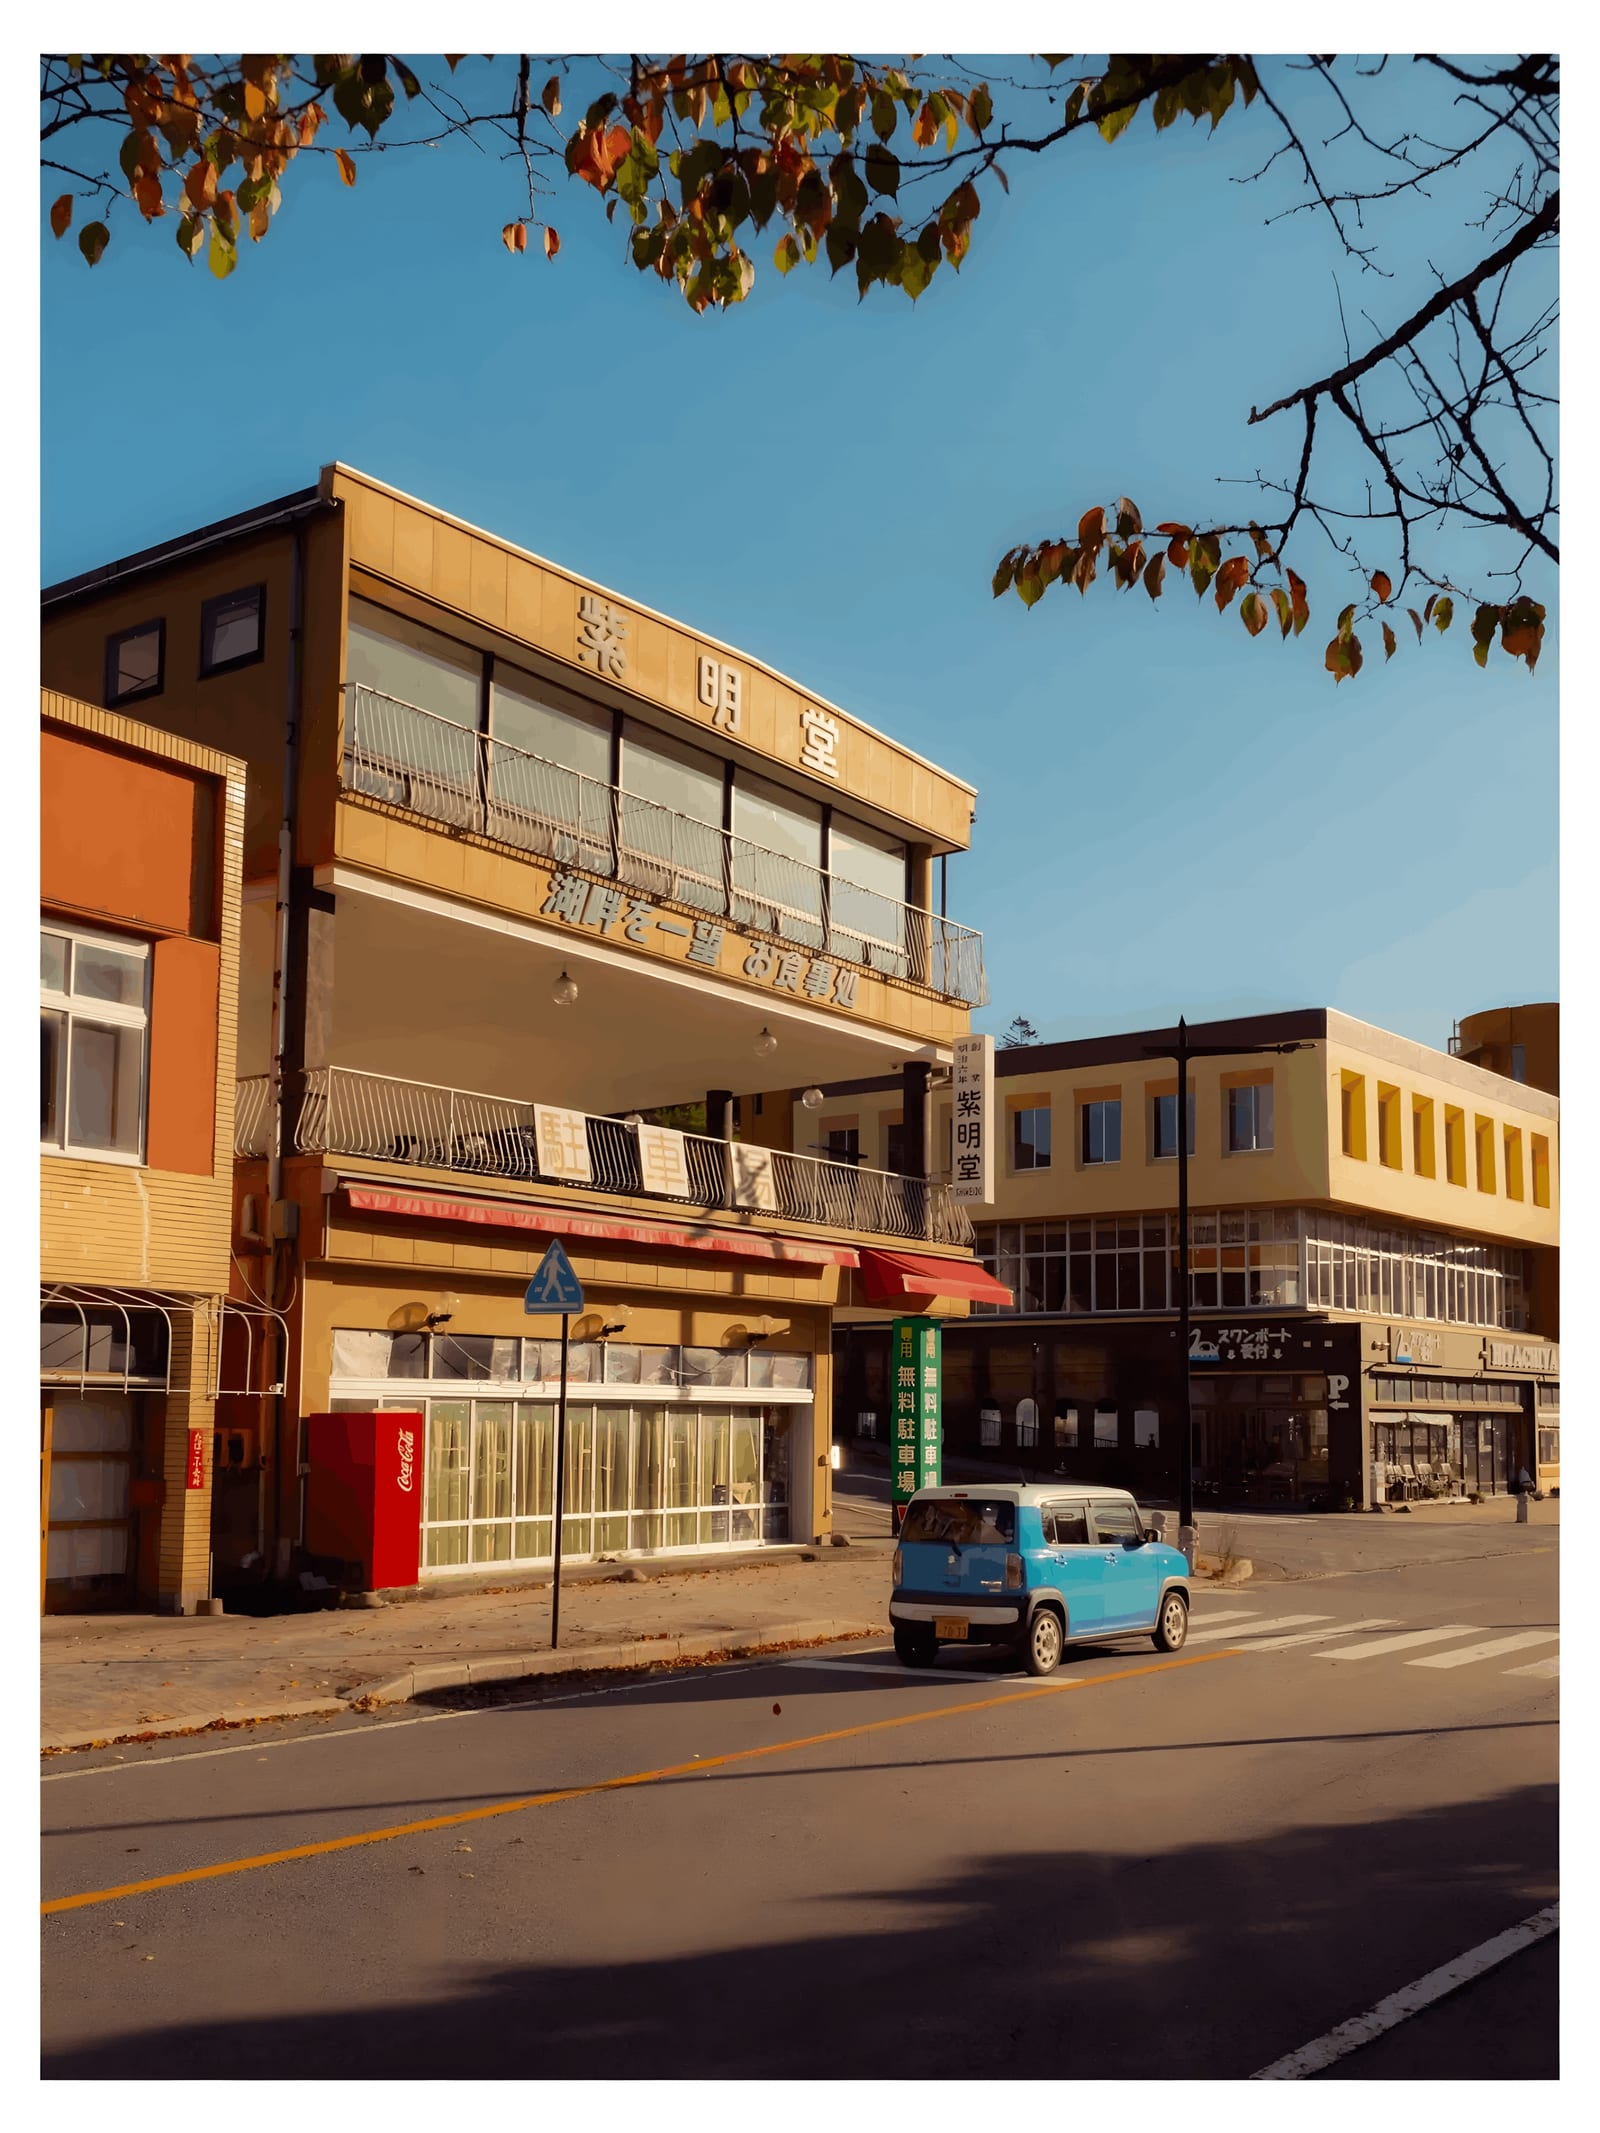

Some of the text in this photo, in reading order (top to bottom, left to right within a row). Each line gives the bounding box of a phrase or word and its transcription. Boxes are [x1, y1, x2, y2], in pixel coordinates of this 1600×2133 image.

[577, 595, 840, 778] 紫明堂
[540, 872, 860, 1009] 湖畔を一望 お食事処
[957, 1089, 981, 1181] 紫明堂
[1218, 1327, 1293, 1344] スワンボート
[1241, 1343, 1270, 1360] 受付
[897, 1366, 916, 1493] 無料駐車場
[1327, 1374, 1350, 1400] P
